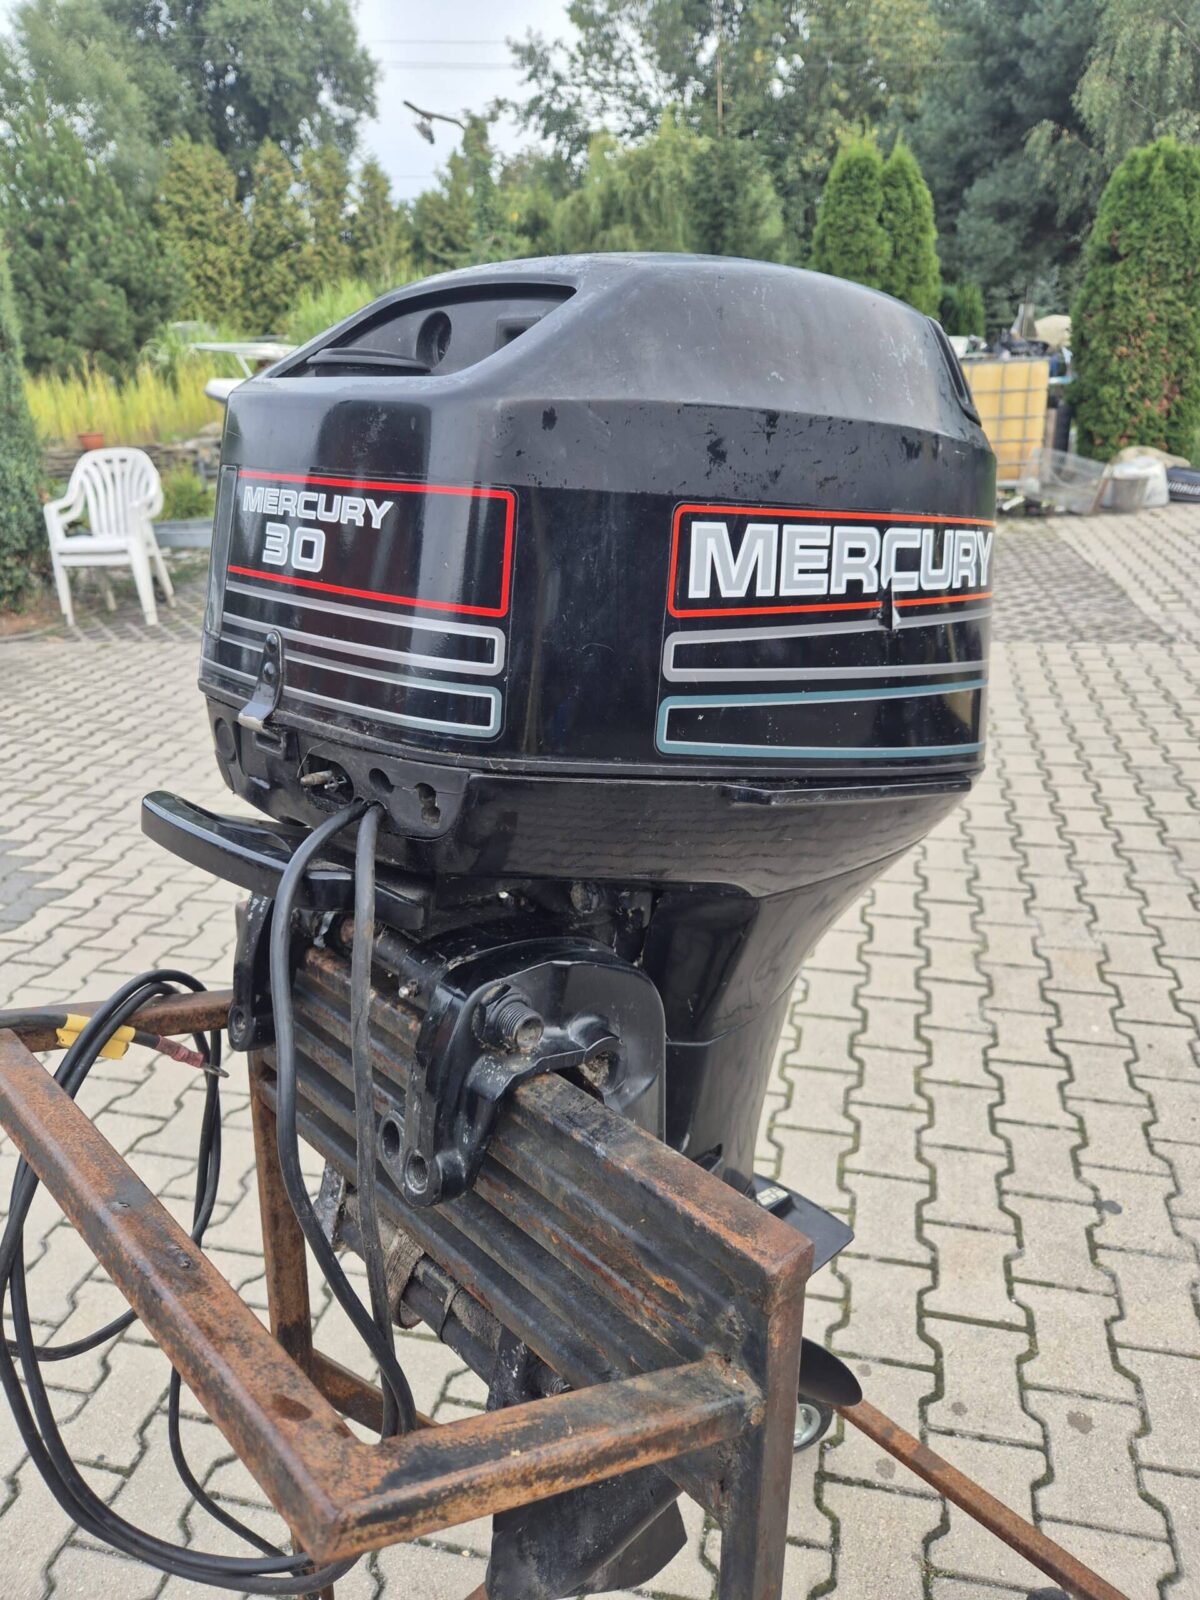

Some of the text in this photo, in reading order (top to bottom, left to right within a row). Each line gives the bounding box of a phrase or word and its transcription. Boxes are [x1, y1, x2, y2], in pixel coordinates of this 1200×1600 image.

[242, 486, 394, 529] MERCURY
[262, 522, 326, 572] 30
[688, 521, 993, 598] MERCURY
